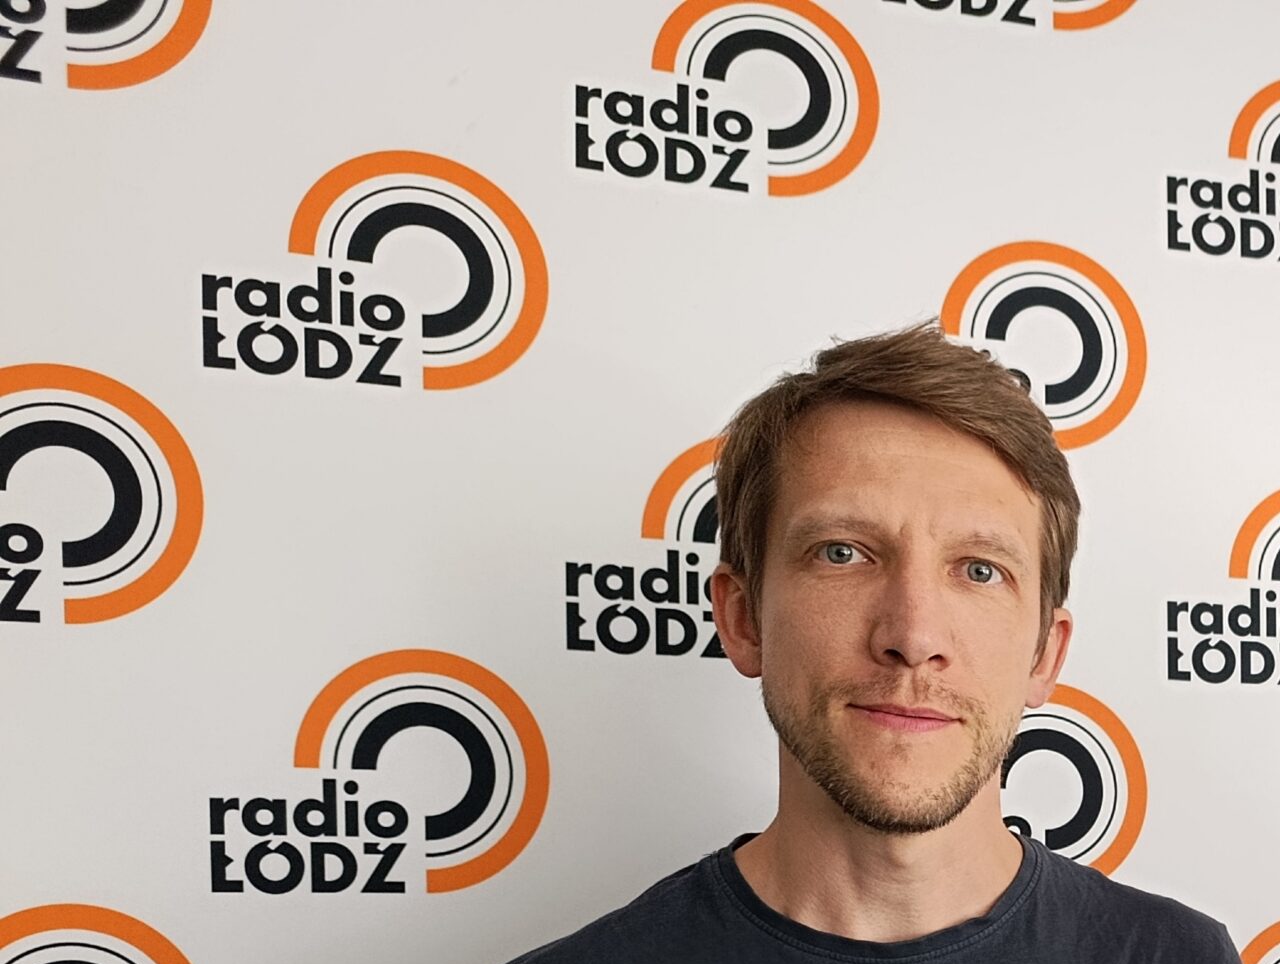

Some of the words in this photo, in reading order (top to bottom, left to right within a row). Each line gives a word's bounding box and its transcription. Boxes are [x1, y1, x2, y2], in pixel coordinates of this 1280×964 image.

[575, 83, 753, 143] radio
[201, 266, 406, 332] radio
[565, 549, 713, 606] radi
[209, 778, 409, 839] radio
